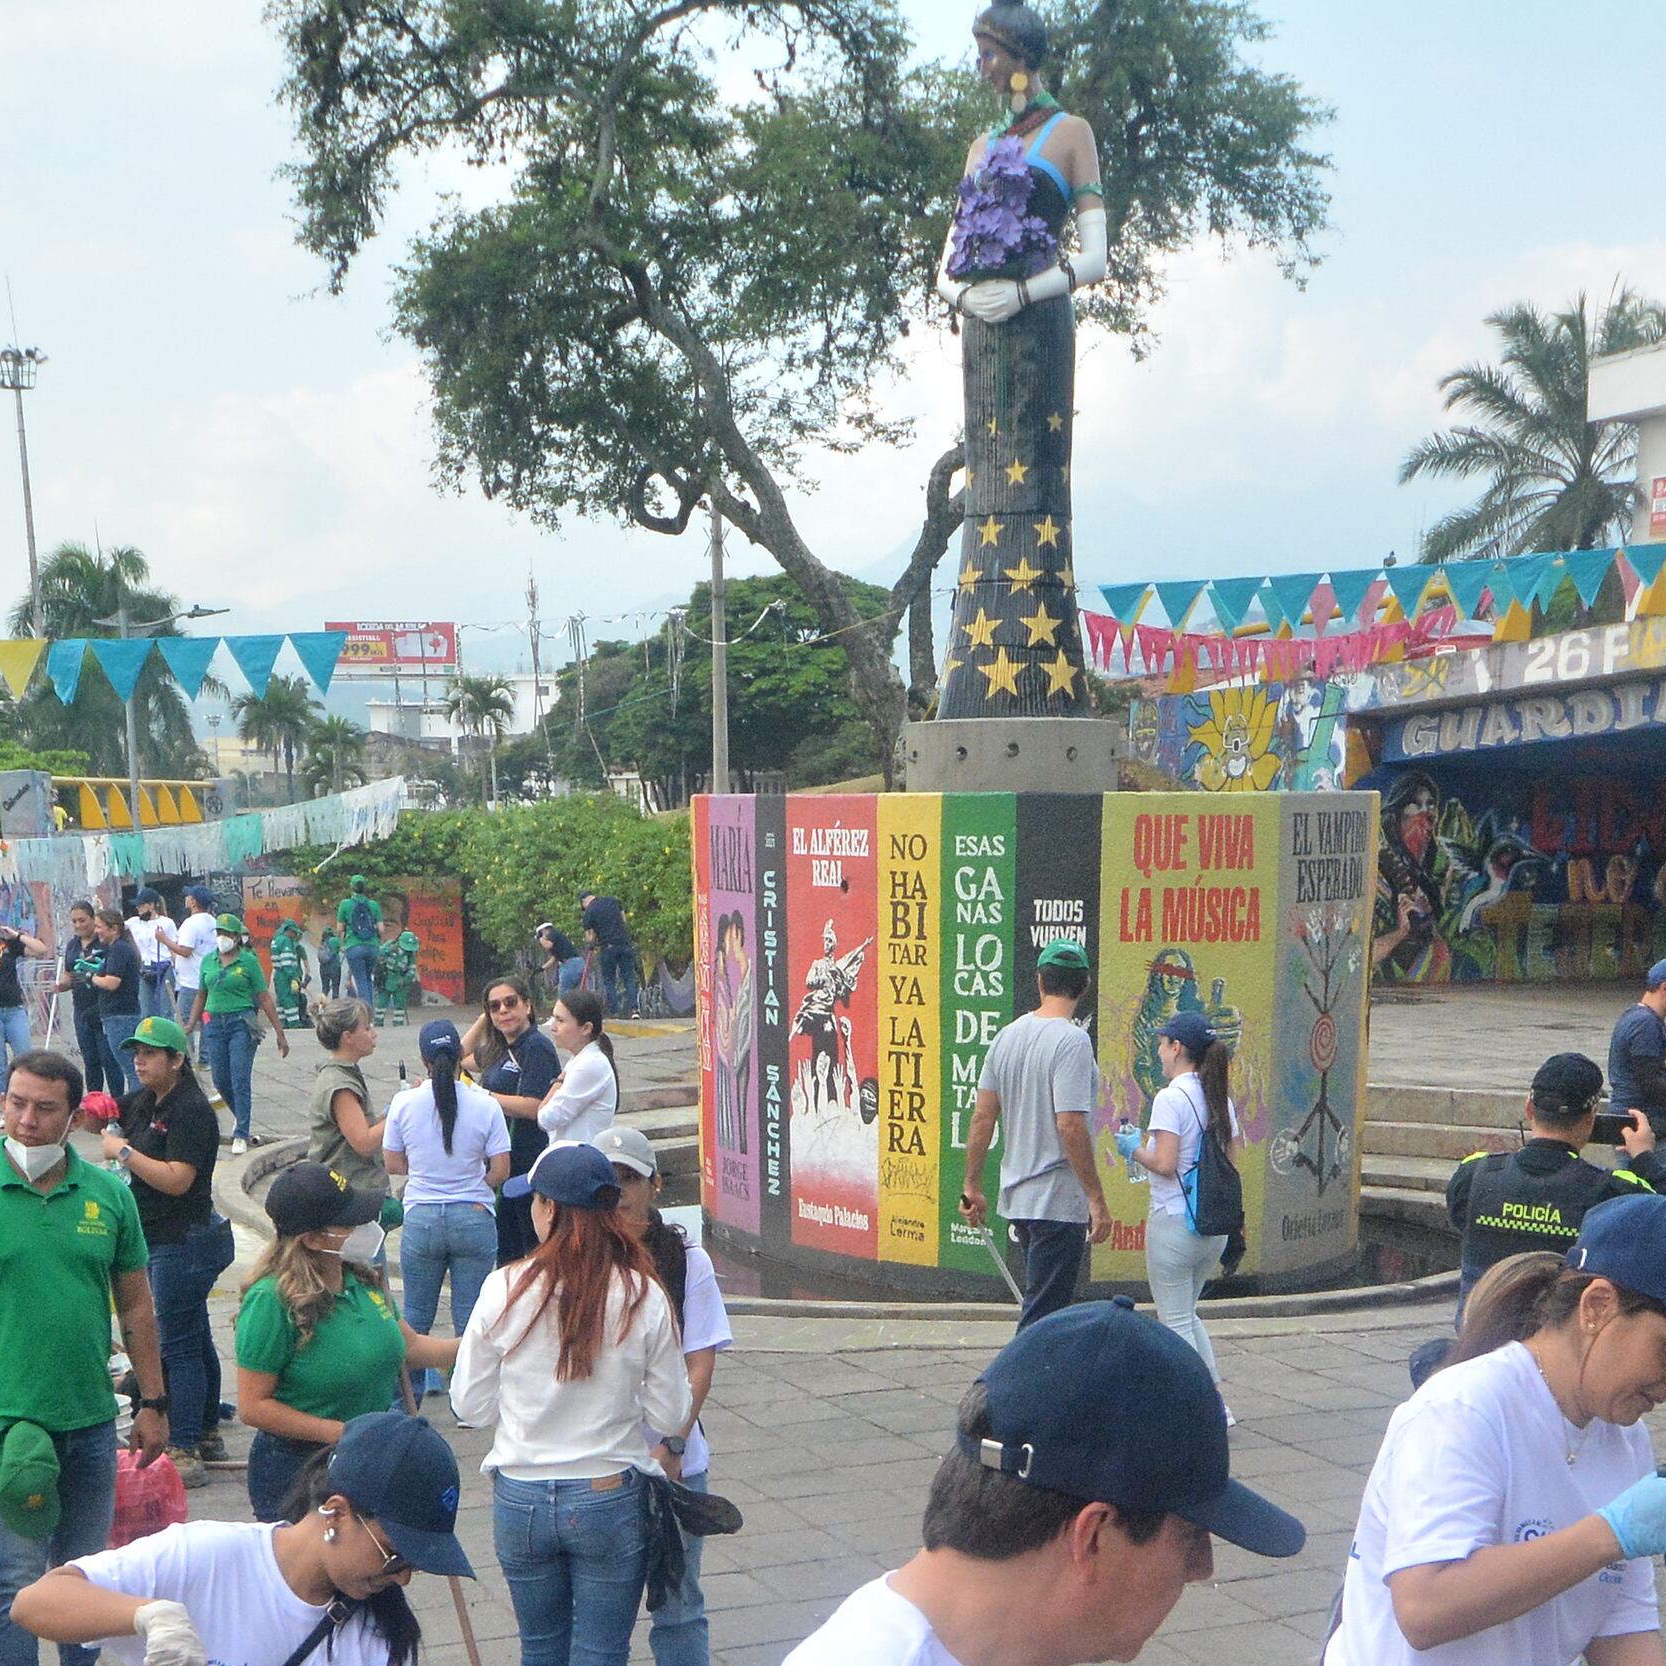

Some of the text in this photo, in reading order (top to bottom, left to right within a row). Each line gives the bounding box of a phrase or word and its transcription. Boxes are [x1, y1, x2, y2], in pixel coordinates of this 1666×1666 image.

[1523, 631, 1591, 684] 26
[710, 804, 753, 894] MARÍA
[792, 828, 808, 855] EL
[810, 820, 869, 857] ALFÉREZ
[890, 834, 927, 861] NO
[955, 835, 1005, 857] ESAS
[1134, 814, 1254, 878] QUE VIVA
[1293, 812, 1312, 856] EL
[247, 879, 266, 900] Te
[812, 859, 845, 888] REAL
[889, 870, 928, 901] HA
[954, 866, 1004, 901] GA
[1296, 857, 1363, 904] ESPERADO
[264, 901, 280, 913] en
[889, 900, 927, 940] BI
[956, 902, 1002, 924] NAS
[1033, 900, 1084, 922] TODOS
[1120, 874, 1260, 943] LA MÚSICA
[763, 870, 780, 1026] CRISTIAN
[888, 942, 928, 966] TAR
[956, 933, 1003, 971] LO
[889, 975, 926, 1006] YA
[954, 972, 1004, 996] CAS
[889, 1016, 926, 1048] LA
[955, 1009, 1001, 1046] DE
[888, 1051, 923, 1089] TI
[888, 1089, 926, 1123] ER
[888, 1122, 926, 1156] RA
[1502, 1202, 1562, 1224] POLICÍA
[890, 1222, 925, 1242] Lerma
